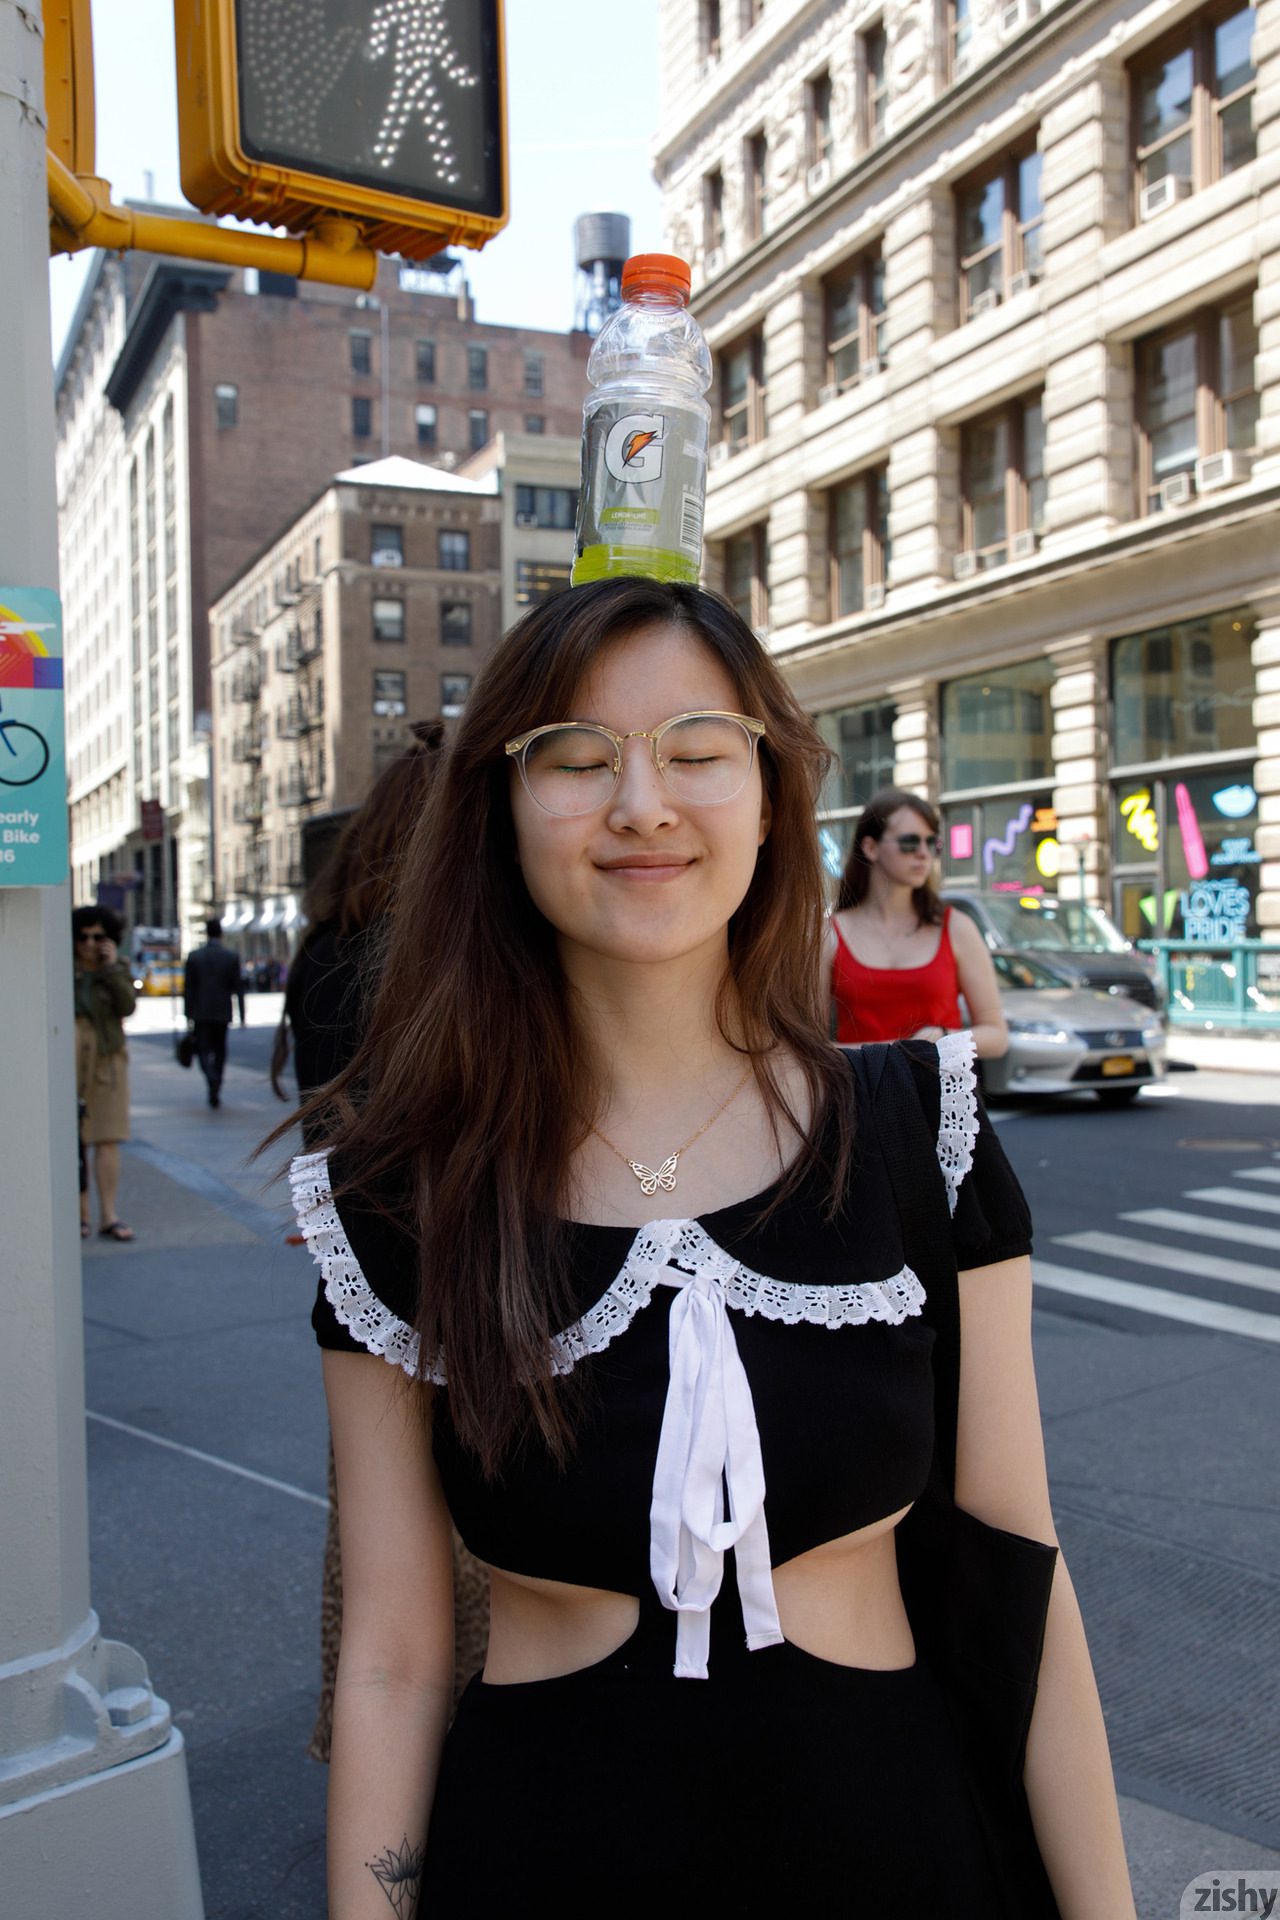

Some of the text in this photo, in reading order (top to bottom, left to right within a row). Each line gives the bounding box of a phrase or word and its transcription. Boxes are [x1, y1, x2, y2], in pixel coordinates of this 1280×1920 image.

[604, 414, 665, 484] G
[3, 829, 40, 844] Bike
[1180, 887, 1250, 919] LOVES
[1184, 917, 1248, 942] PRIDE
